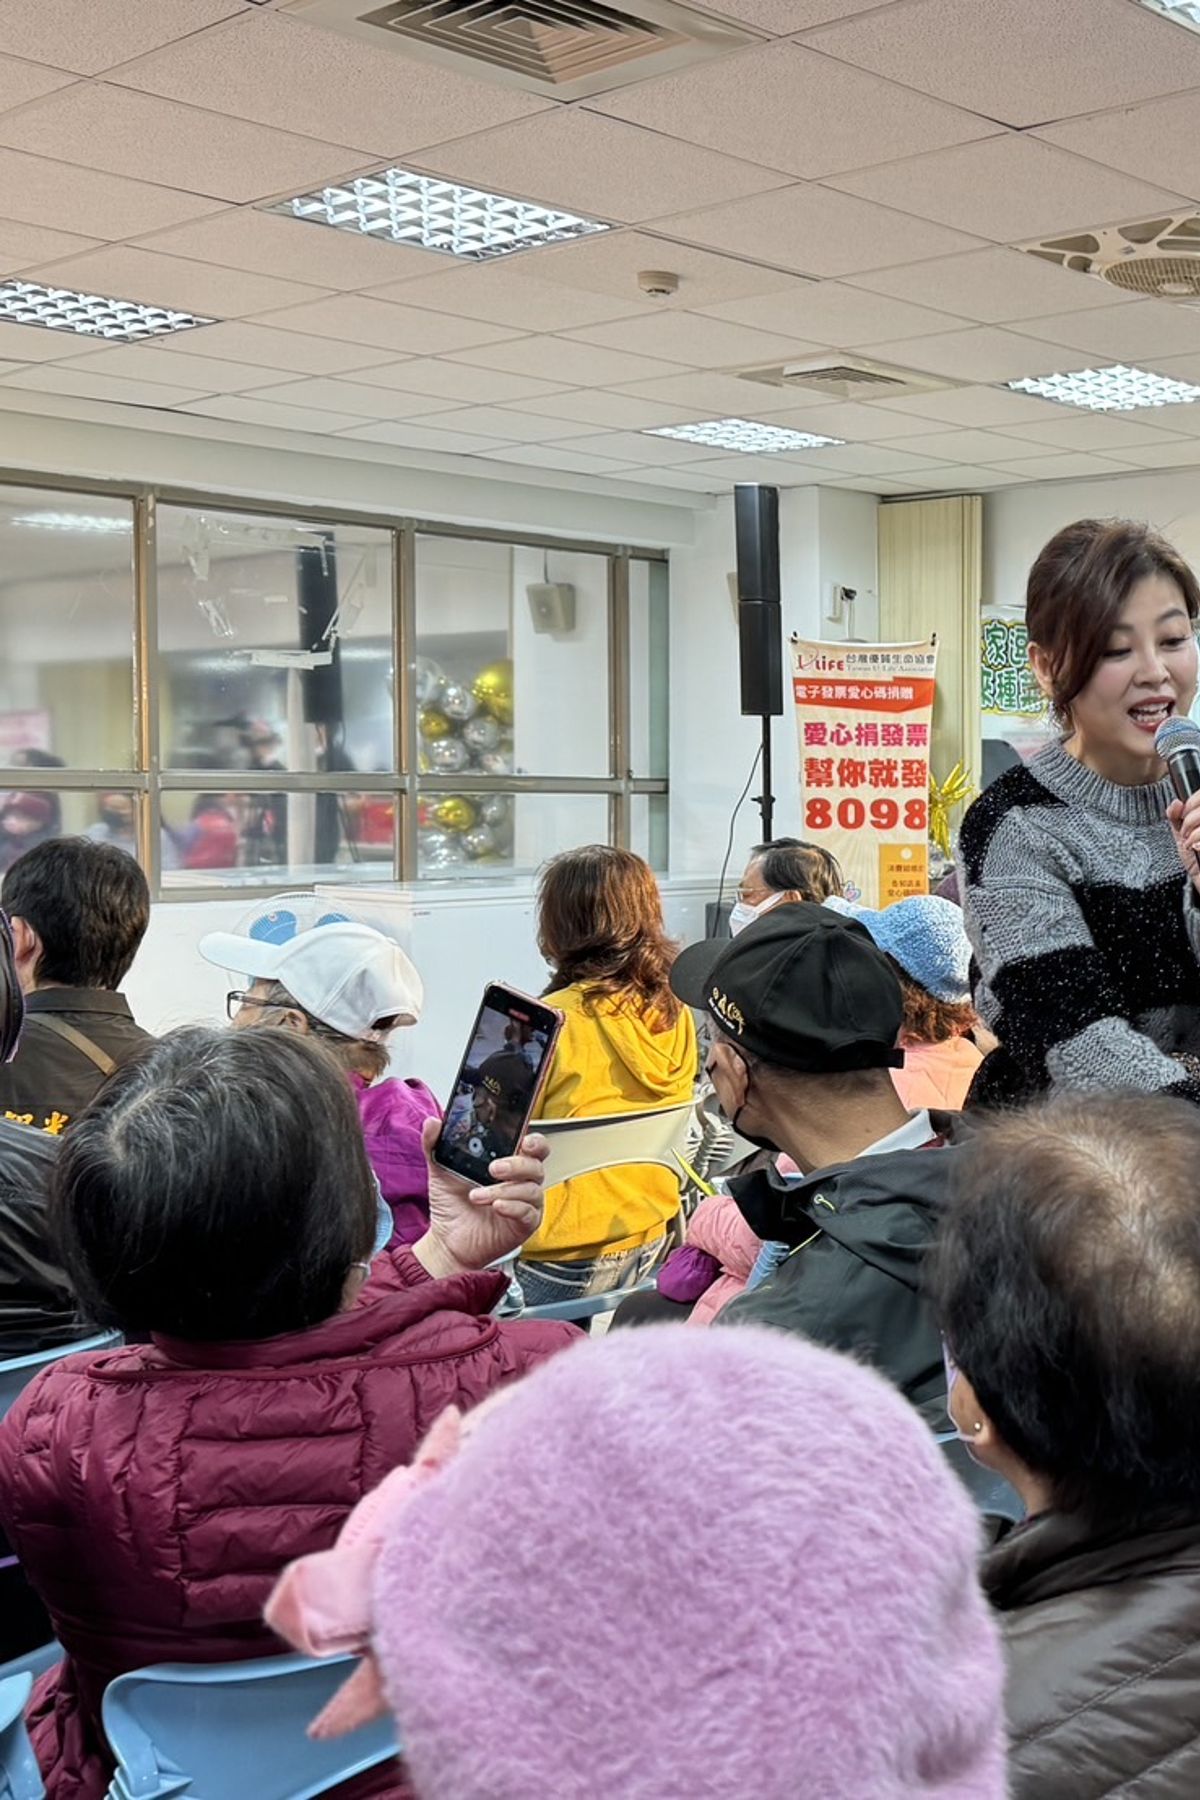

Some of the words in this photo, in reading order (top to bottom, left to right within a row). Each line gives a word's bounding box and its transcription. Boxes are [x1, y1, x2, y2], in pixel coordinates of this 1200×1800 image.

[804, 722, 928, 747] 愛心捐發票
[804, 757, 927, 789] 幫你就發
[805, 798, 927, 830] 8098
